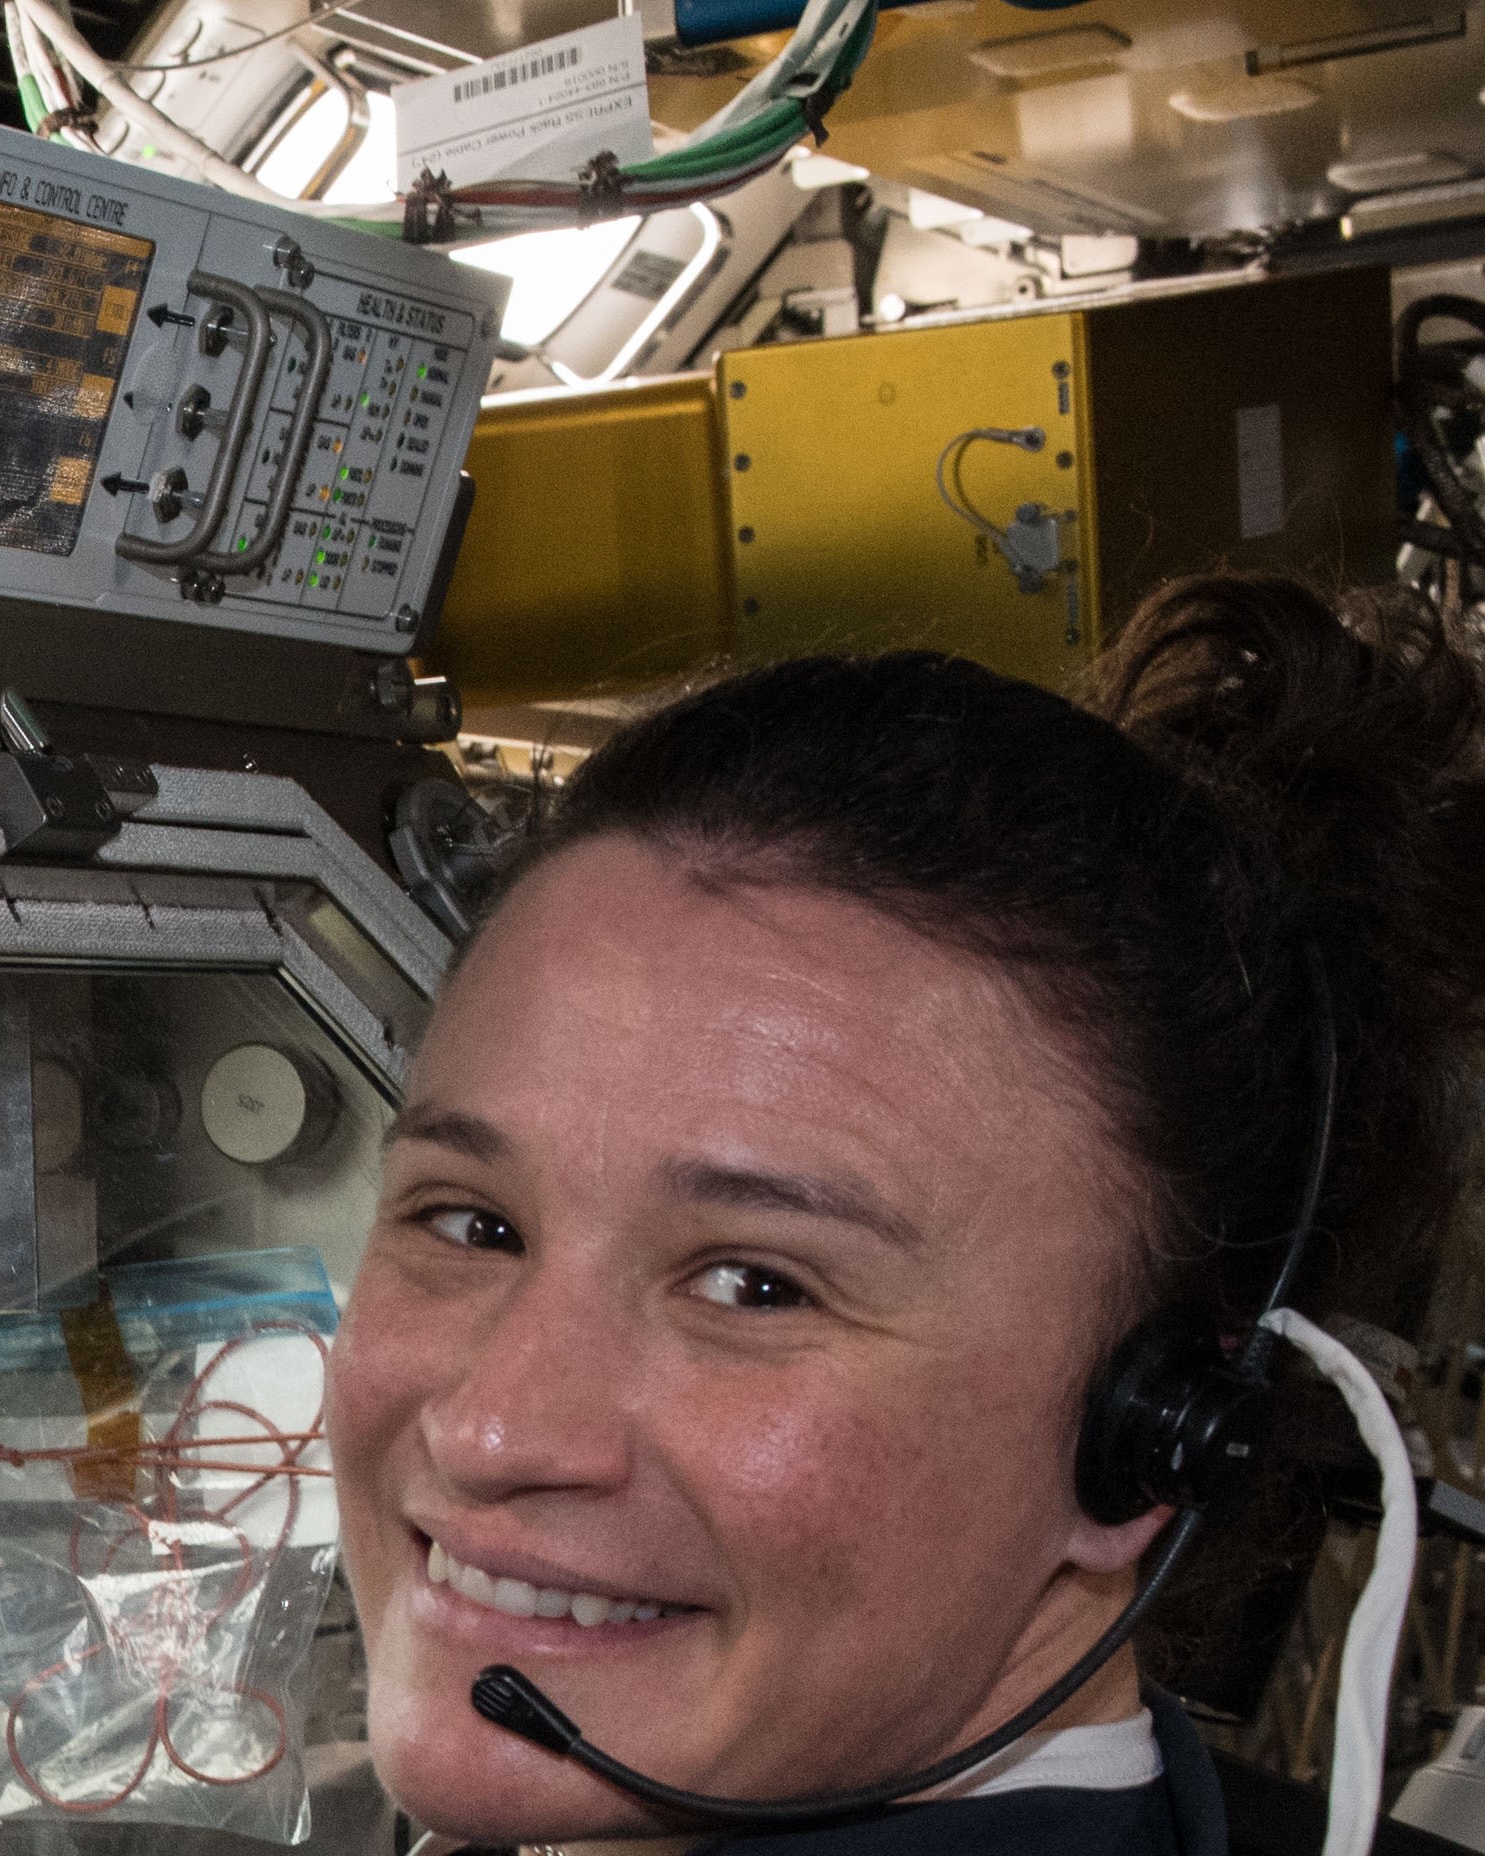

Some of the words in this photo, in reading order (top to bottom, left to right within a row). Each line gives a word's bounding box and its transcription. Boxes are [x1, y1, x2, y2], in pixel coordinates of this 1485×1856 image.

[487, 126, 525, 146] Power
[34, 180, 82, 216] CONTROL
[85, 192, 130, 227] CENTRE
